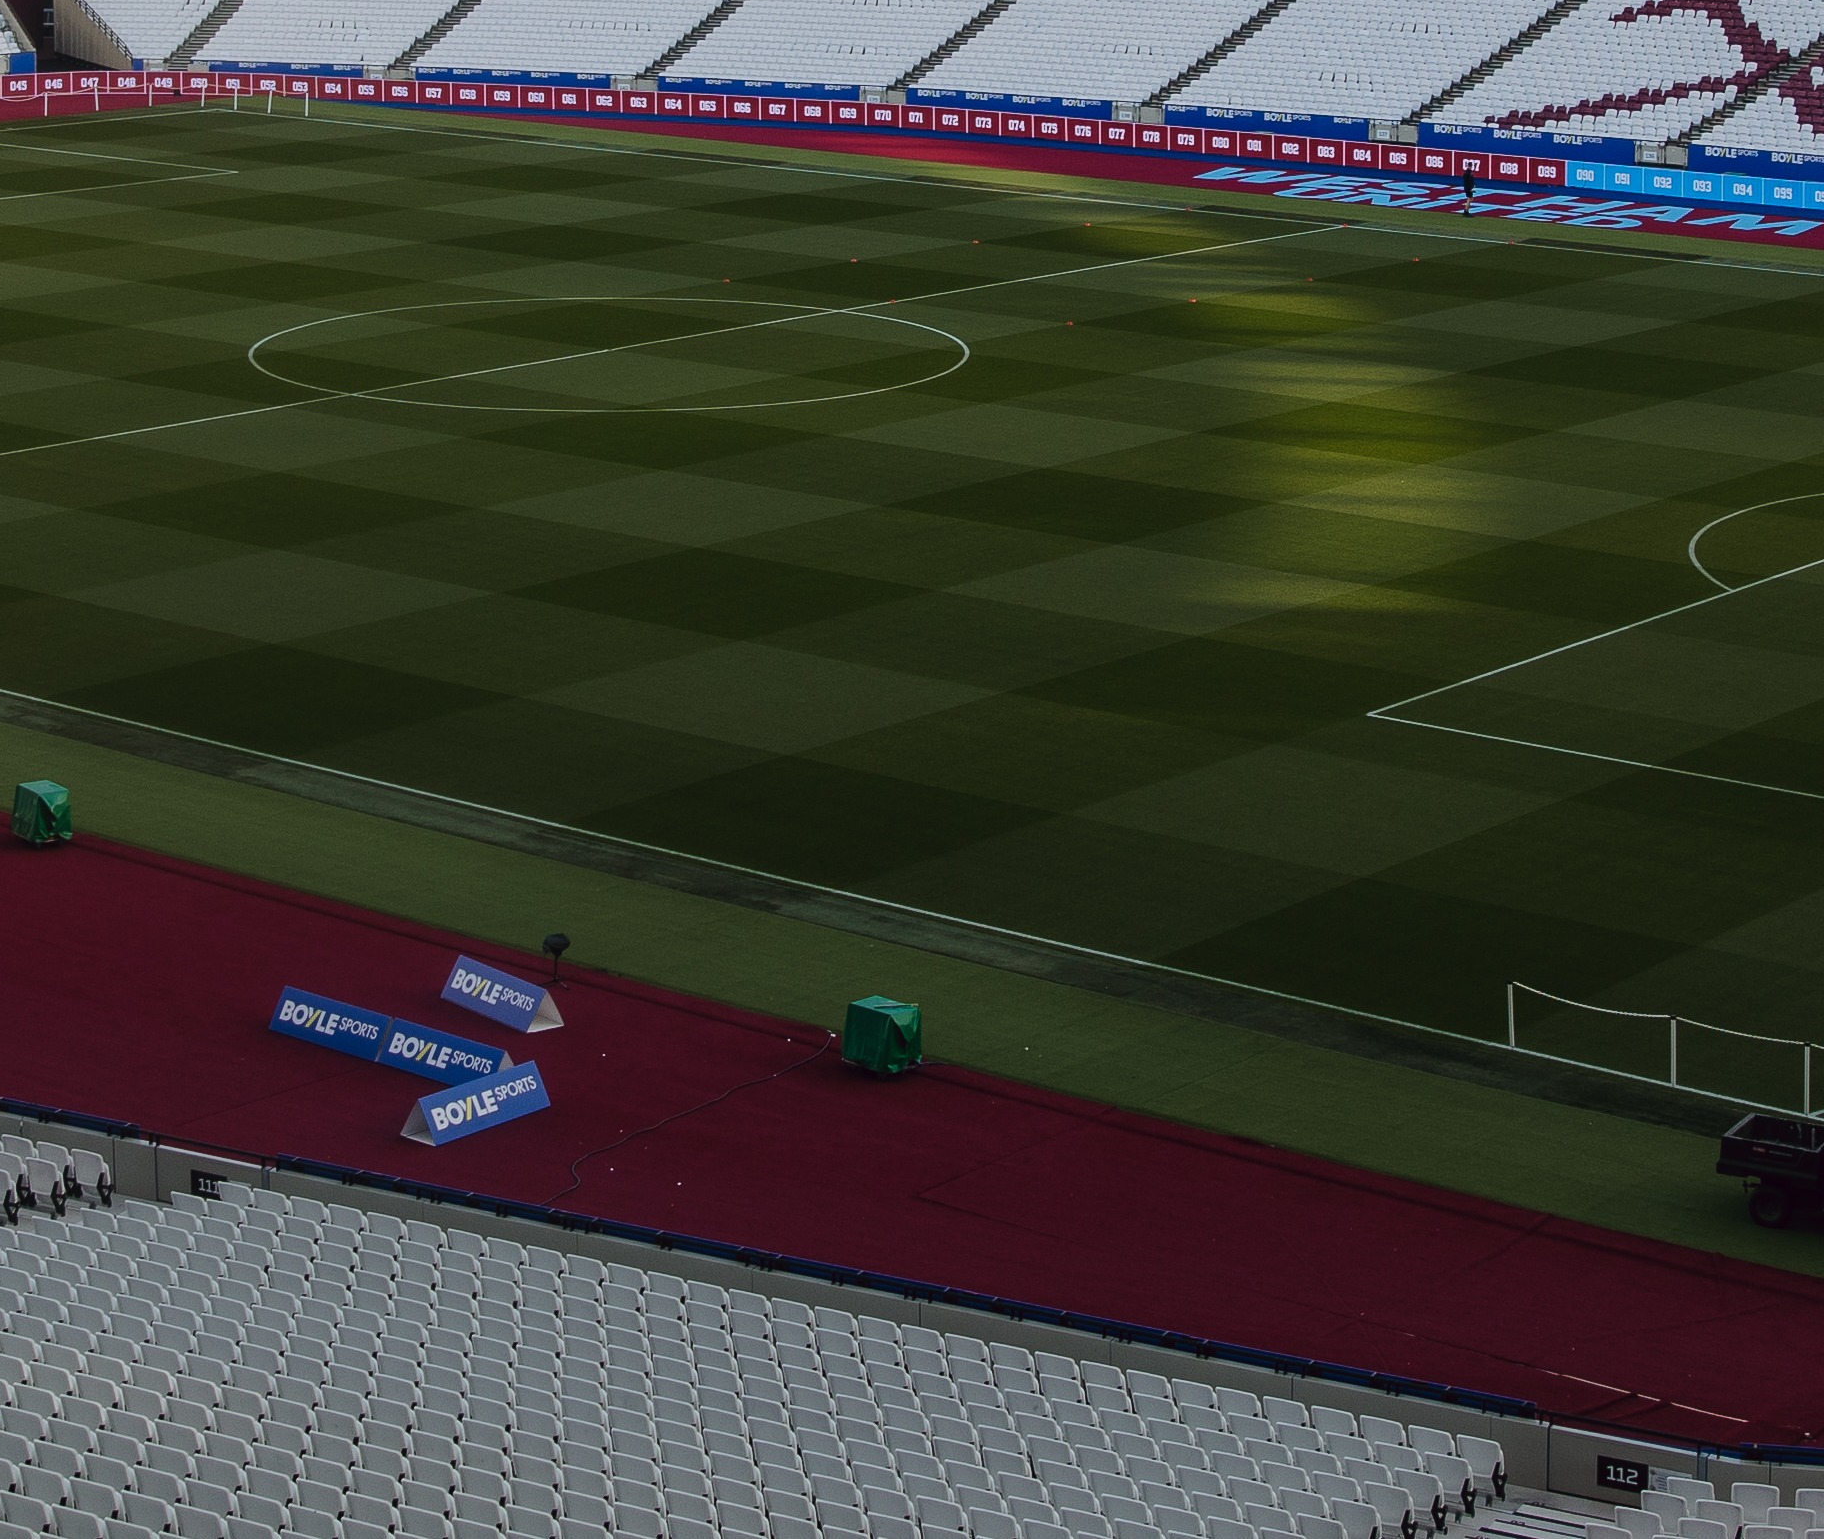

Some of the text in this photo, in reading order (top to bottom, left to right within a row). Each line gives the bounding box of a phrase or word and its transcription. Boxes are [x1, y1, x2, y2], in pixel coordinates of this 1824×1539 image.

[10, 81, 27, 91] 045
[325, 83, 341, 94] 054
[528, 92, 544, 102] 060
[734, 102, 751, 113] 066
[909, 112, 923, 123] 071
[1109, 128, 1125, 140] 077
[1282, 143, 1299, 154] 082
[1705, 146, 1737, 158] BOYLE
[1426, 156, 1443, 168] 086
[1654, 176, 1672, 188] 092
[1193, 166, 1824, 236] WEST HAM
[1274, 187, 1642, 229] UNITED
[450, 968, 535, 1012] BOYLE SPORTS
[279, 999, 380, 1040] BOYLE SPORTS
[388, 1032, 493, 1075] BOYLE SPORTS
[430, 1075, 537, 1131] BOYLE SPORTS
[198, 1178, 220, 1195] 111
[1606, 1465, 1639, 1485] 112
